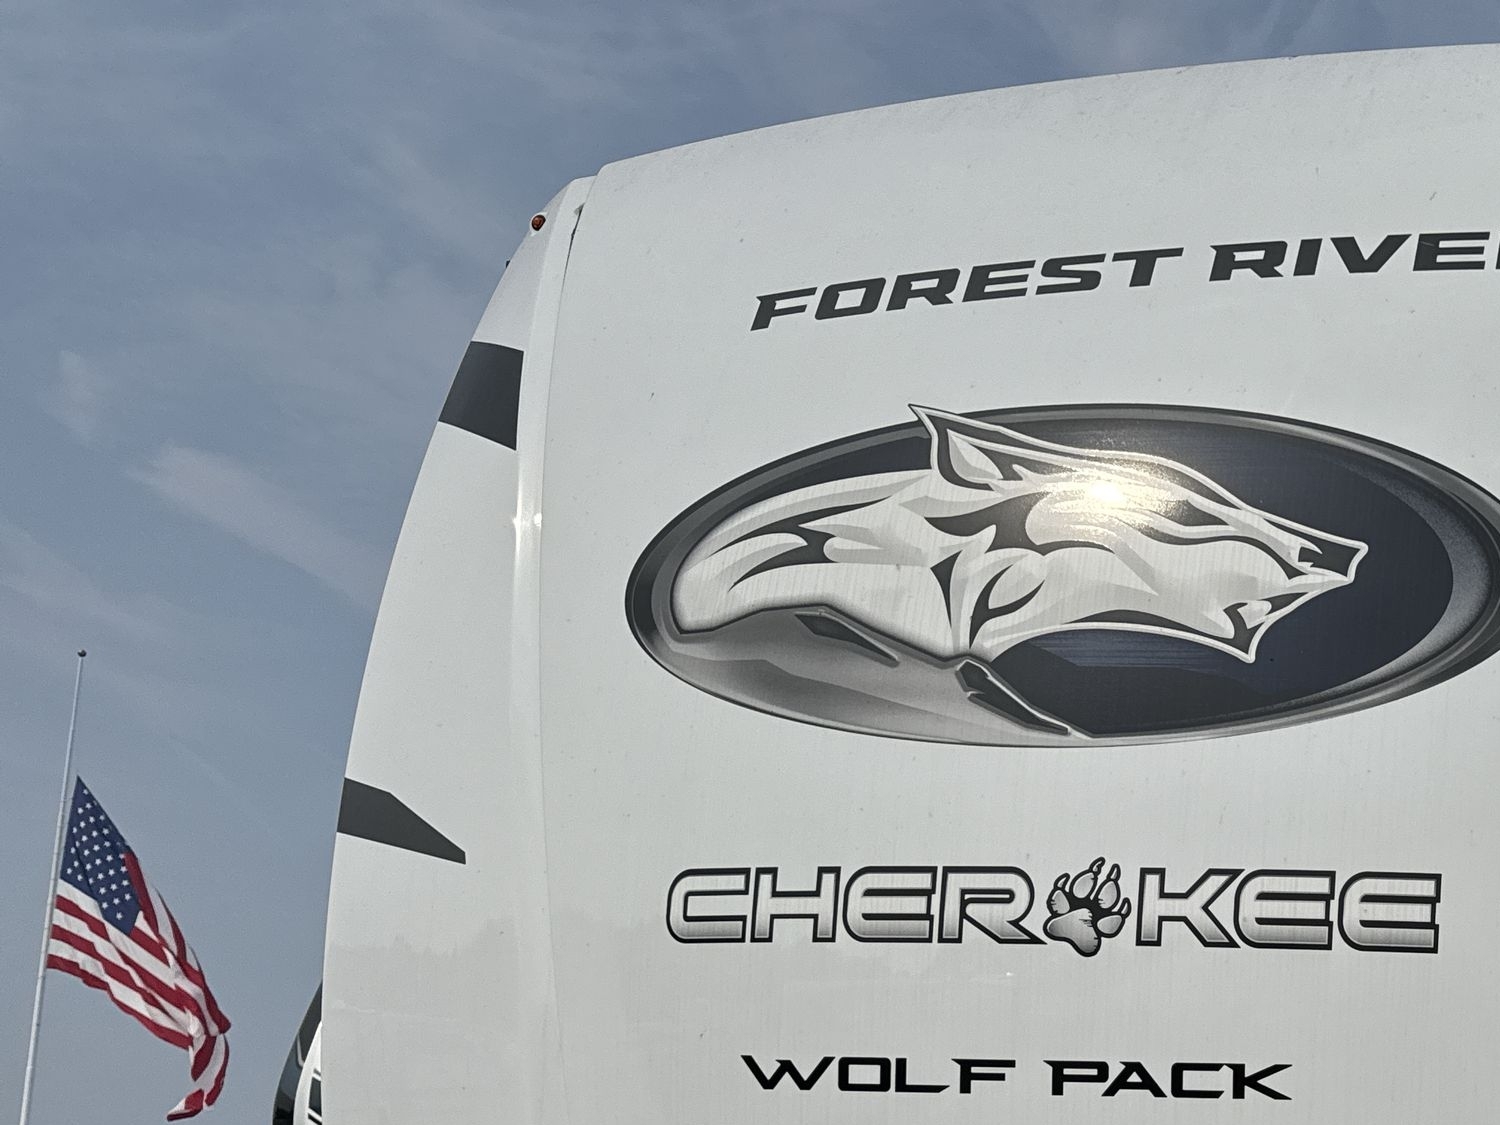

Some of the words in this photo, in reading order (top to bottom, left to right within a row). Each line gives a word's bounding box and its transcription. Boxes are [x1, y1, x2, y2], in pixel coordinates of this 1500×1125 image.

[750, 246, 1184, 331] FOREST
[666, 856, 1442, 957] CHERKEE
[740, 1055, 1016, 1094] WOLF
[1042, 1058, 1293, 1100] PACK
